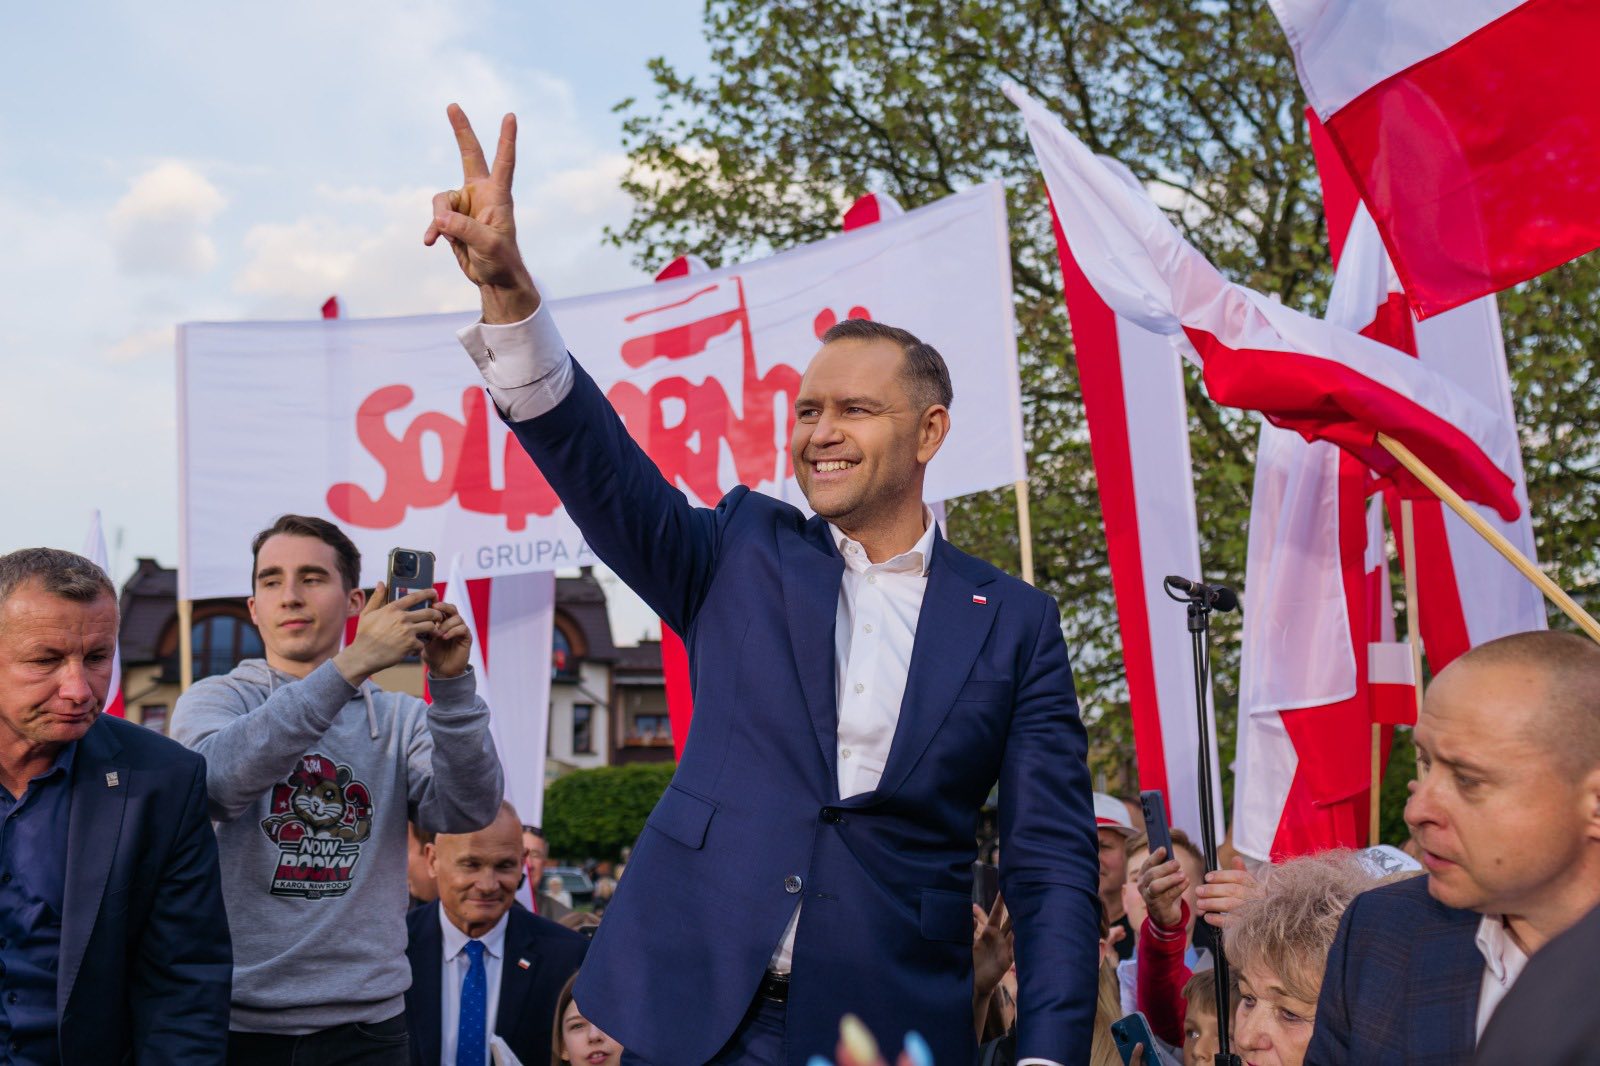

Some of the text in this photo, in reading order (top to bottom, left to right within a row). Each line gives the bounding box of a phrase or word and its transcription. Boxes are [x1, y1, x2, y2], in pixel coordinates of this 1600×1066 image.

[477, 539, 569, 569] GRUPA
[299, 839, 340, 855] NOW
[277, 854, 357, 881] ROCKY
[280, 881, 306, 889] KAROL
